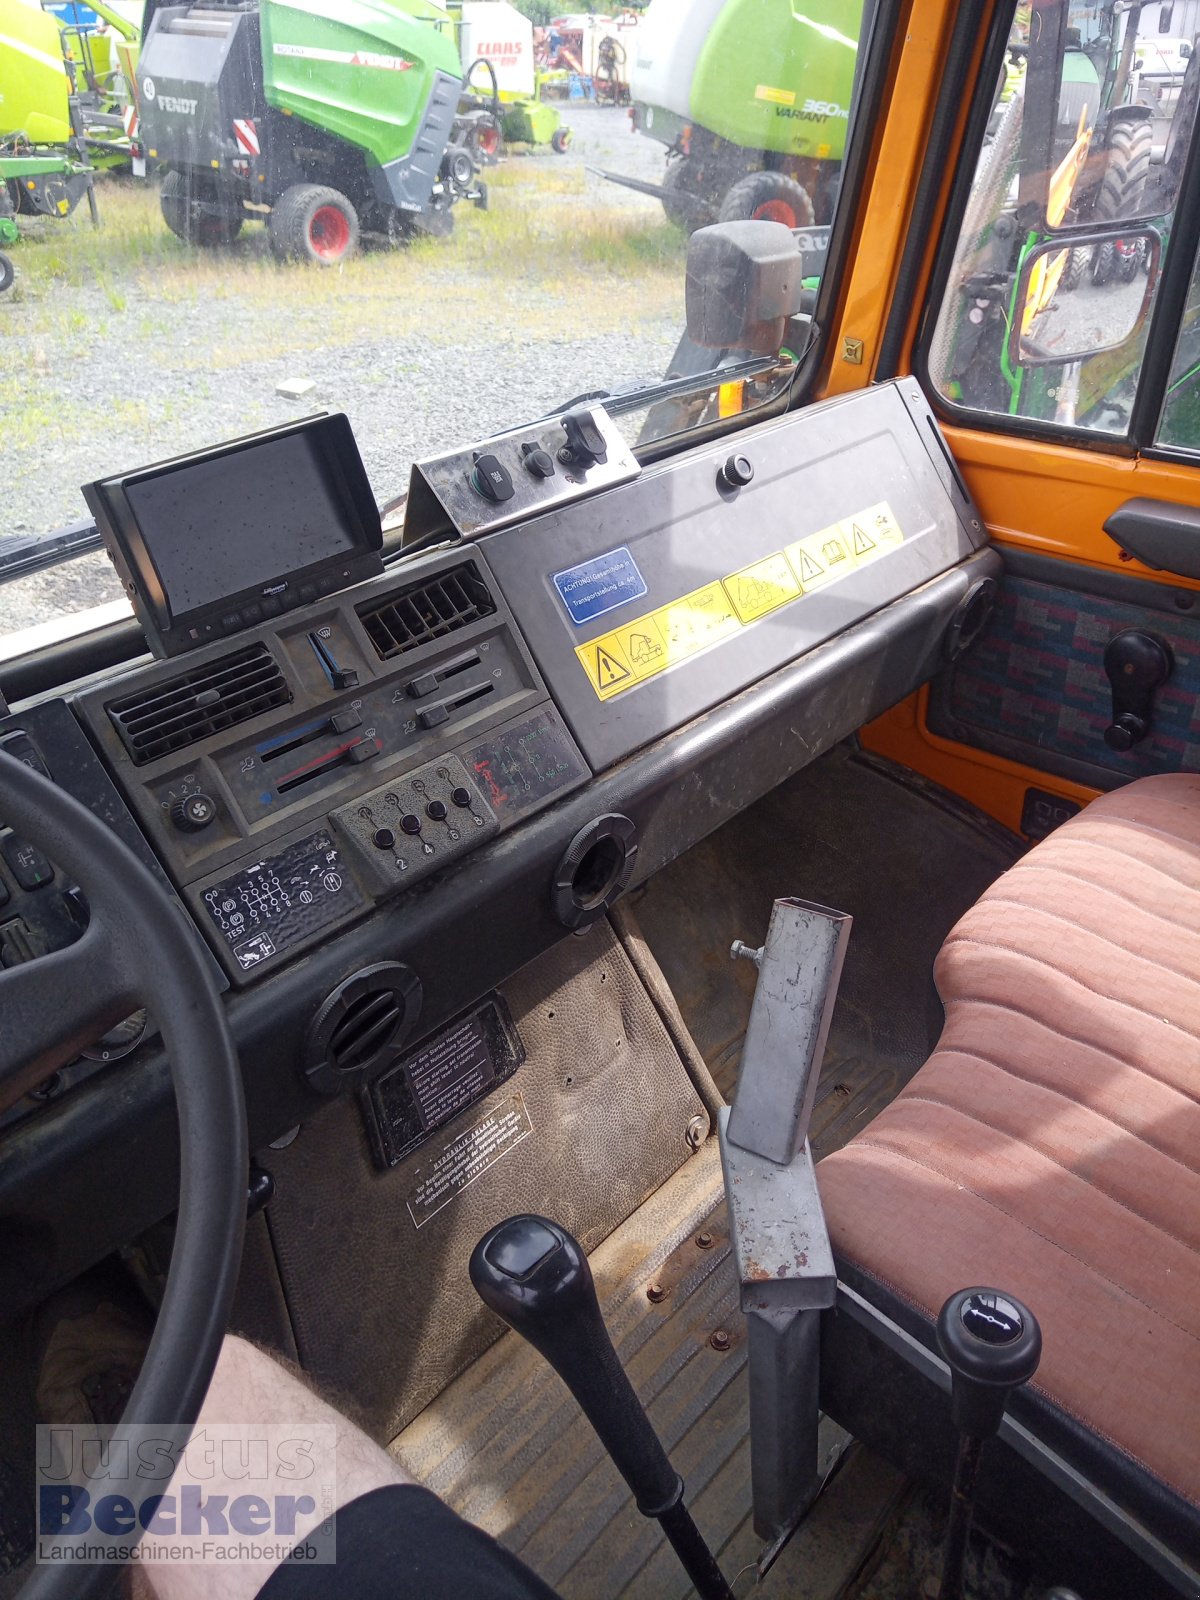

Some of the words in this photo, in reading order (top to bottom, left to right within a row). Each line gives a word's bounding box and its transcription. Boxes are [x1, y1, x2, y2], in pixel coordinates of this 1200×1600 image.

[477, 42, 523, 55] CLAAS
[157, 95, 198, 115] FENDT
[775, 106, 829, 124] VARIANT
[181, 784, 189, 794] 2
[396, 859, 408, 870] 2
[424, 844, 434, 854] 4
[449, 829, 459, 840] 6
[474, 816, 483, 826] 8
[247, 880, 255, 889] 3
[257, 874, 264, 884] 5
[268, 869, 275, 878] 7
[254, 916, 261, 925] 2
[265, 910, 272, 918] 4
[275, 905, 282, 913] 6
[285, 899, 292, 908] 8
[225, 924, 246, 940] TEST
